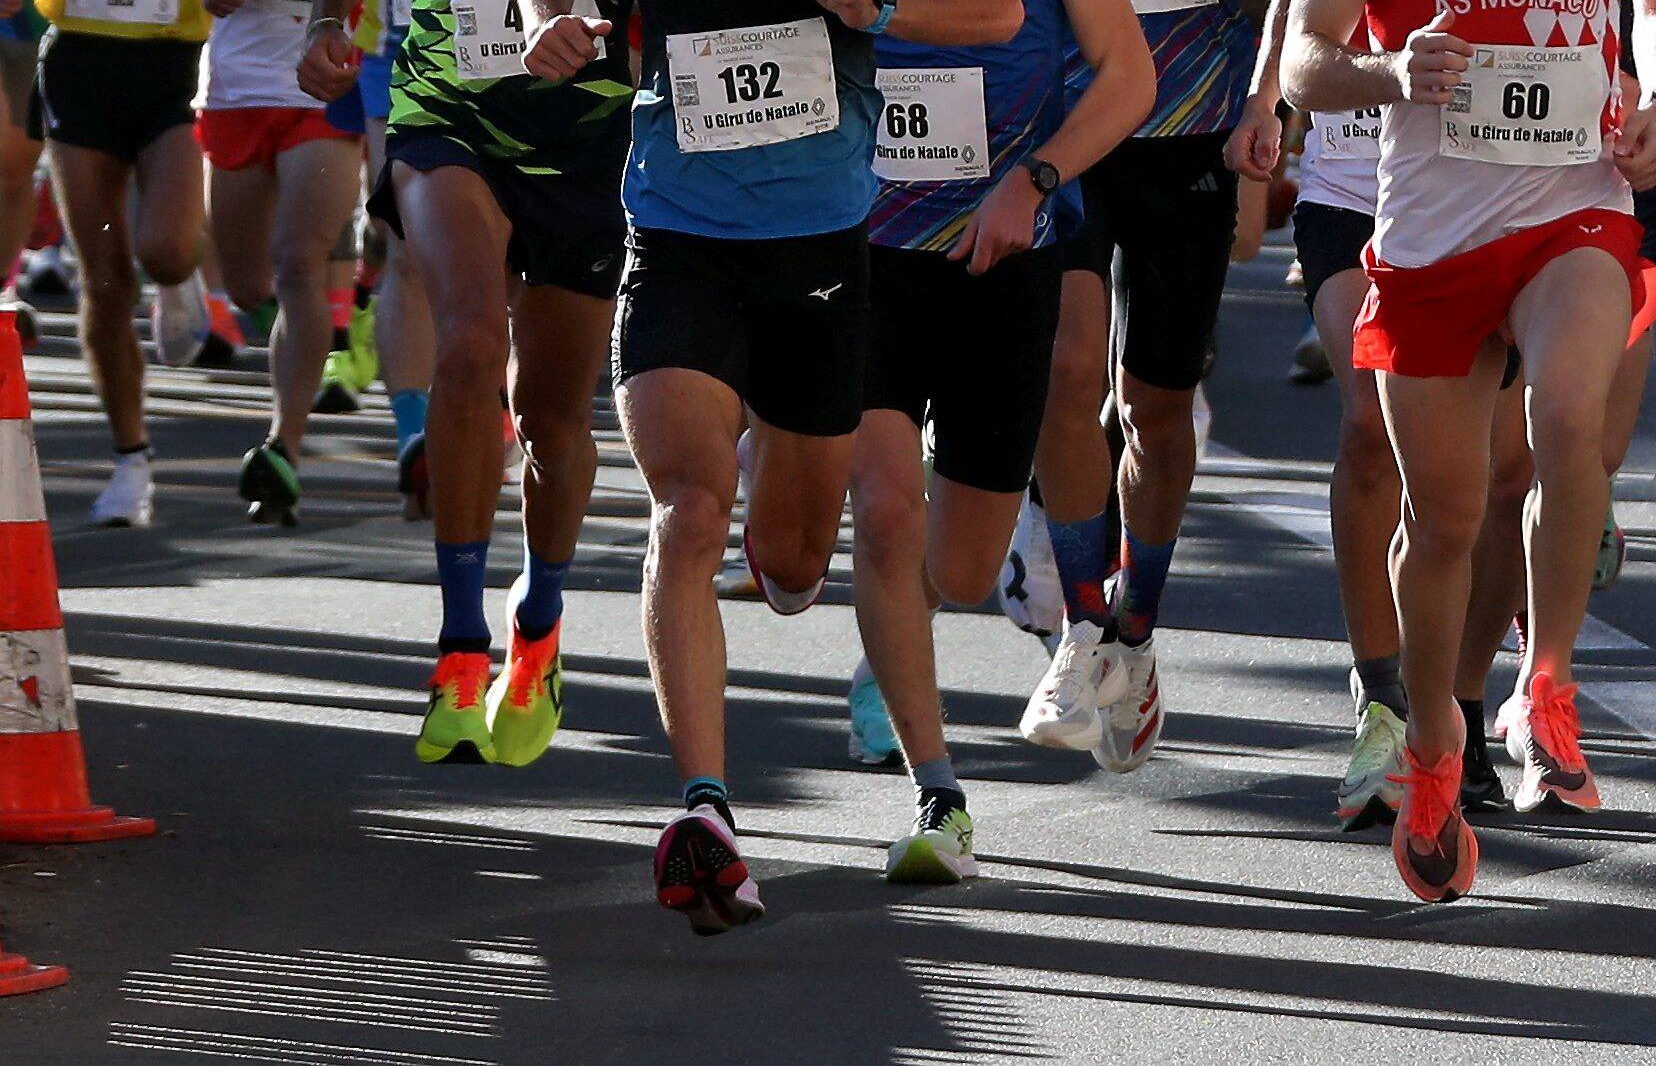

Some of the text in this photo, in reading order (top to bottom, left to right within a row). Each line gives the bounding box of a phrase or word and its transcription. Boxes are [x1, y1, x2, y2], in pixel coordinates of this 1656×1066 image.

[713, 27, 800, 46] SUISSCOURTAGE
[480, 44, 489, 57] U
[491, 42, 517, 56] Giru
[1497, 51, 1582, 63] SUISSCOURTAGE
[717, 61, 784, 104] 132
[1502, 82, 1550, 121] 60
[704, 102, 809, 129] U Giru de Natale
[886, 103, 929, 139] 68
[1342, 124, 1350, 137] U
[1470, 125, 1573, 143] U Giru de Natale
[876, 144, 958, 160] Giru de Natale
